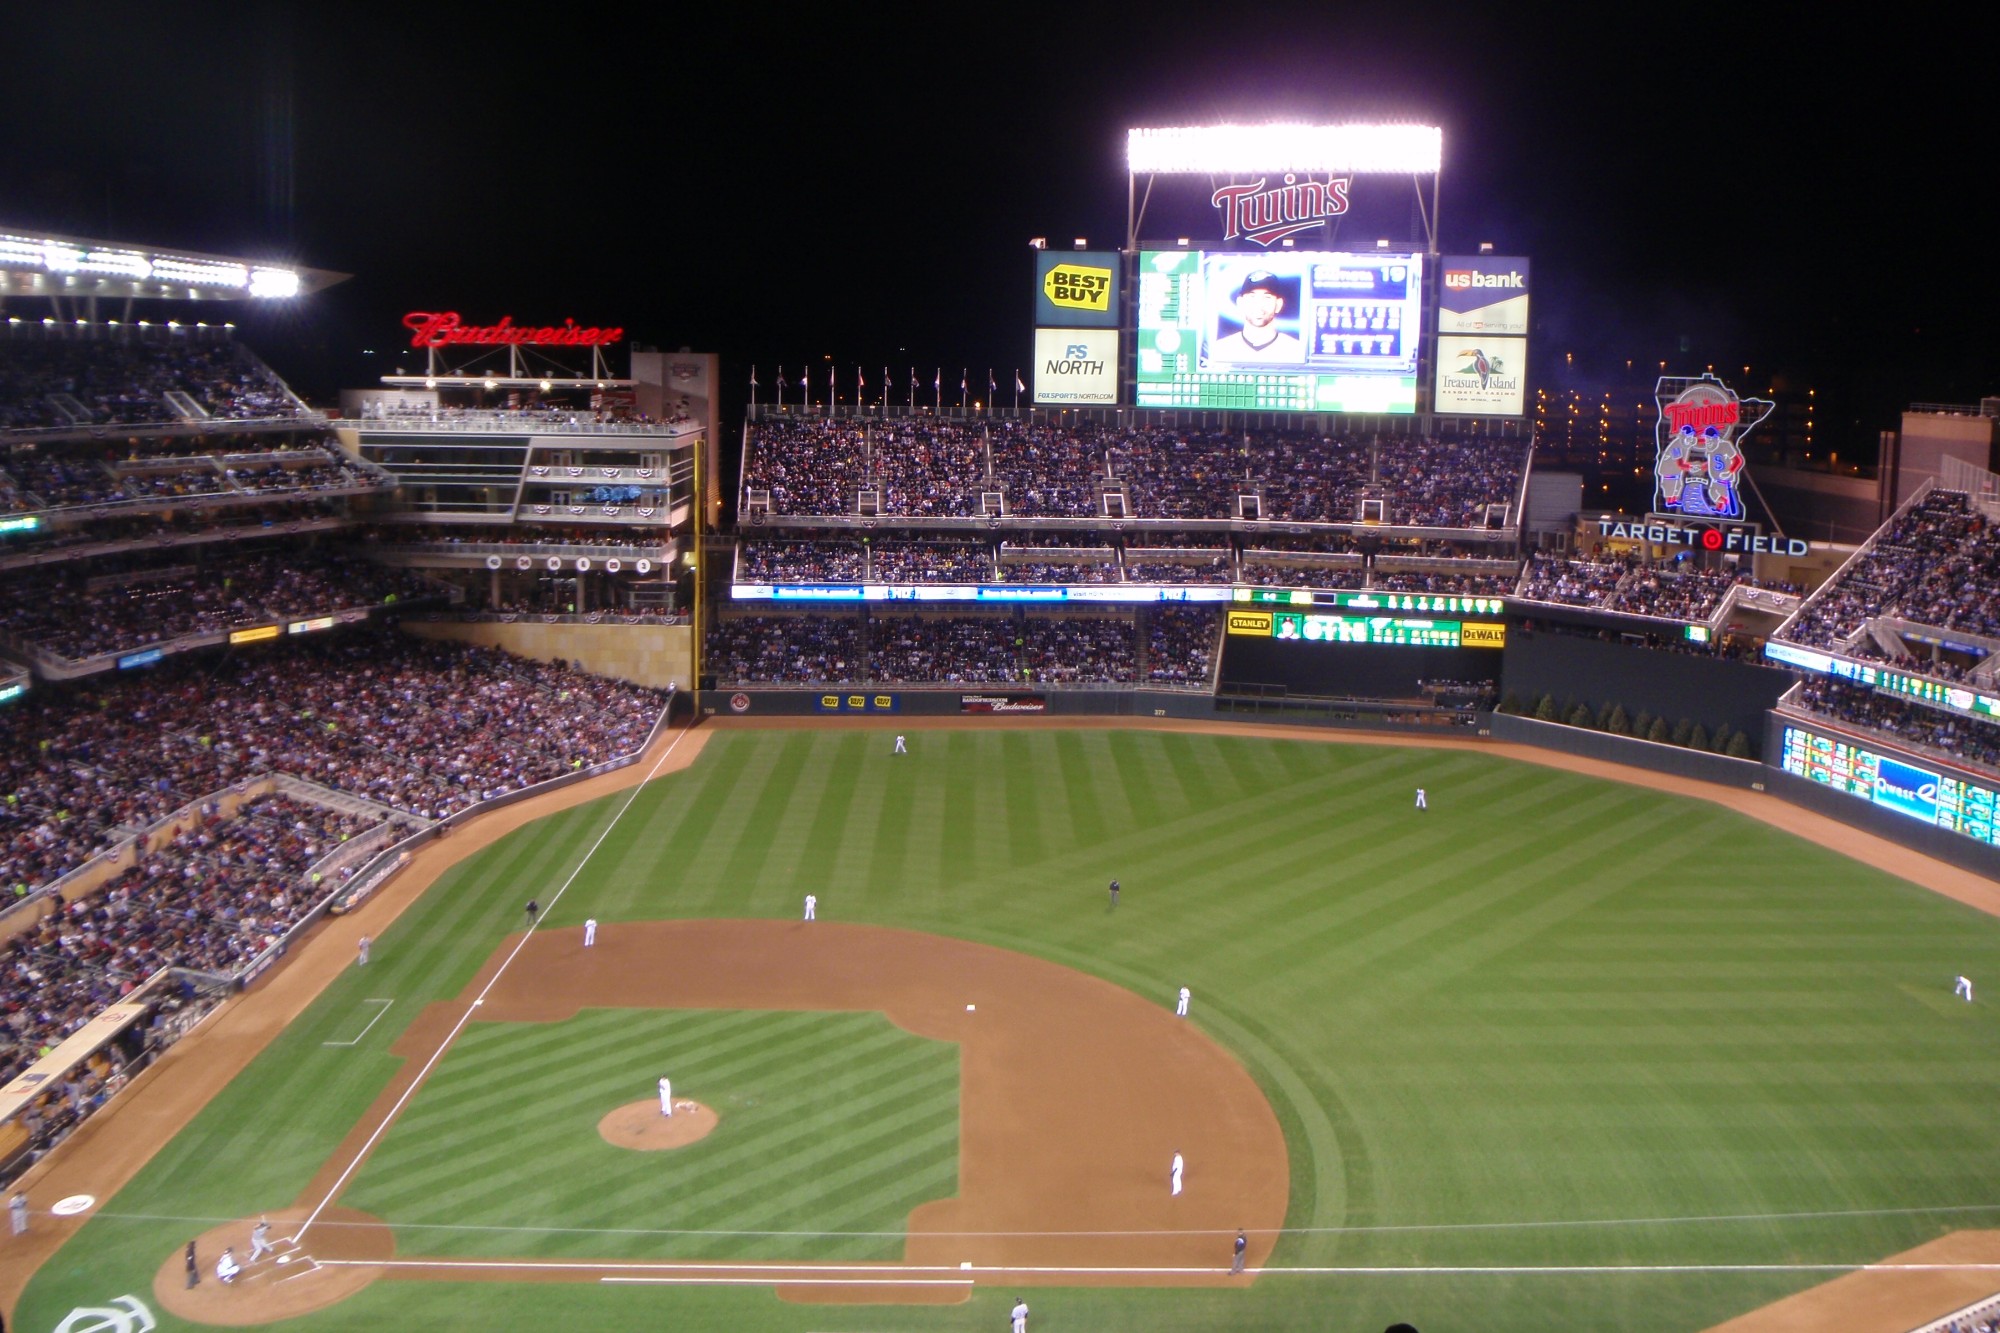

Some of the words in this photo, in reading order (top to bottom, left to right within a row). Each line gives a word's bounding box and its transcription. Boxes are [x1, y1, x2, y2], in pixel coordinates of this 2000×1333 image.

[1211, 173, 1349, 241] Twins
[1053, 271, 1108, 290] BEST
[1054, 286, 1102, 303] BUY
[403, 312, 624, 347] Budweiser
[1065, 344, 1088, 360] FS
[1046, 360, 1104, 375] NORTH
[1442, 374, 1480, 389] Treasure
[1489, 375, 1516, 390] Island
[1663, 399, 1739, 437] Twins
[1599, 521, 1699, 546] TARGET
[1727, 534, 1808, 556] FIELD
[1232, 619, 1268, 628] STANLEY
[991, 702, 1044, 711] Budweiser
[1876, 777, 1916, 801] Qwest
